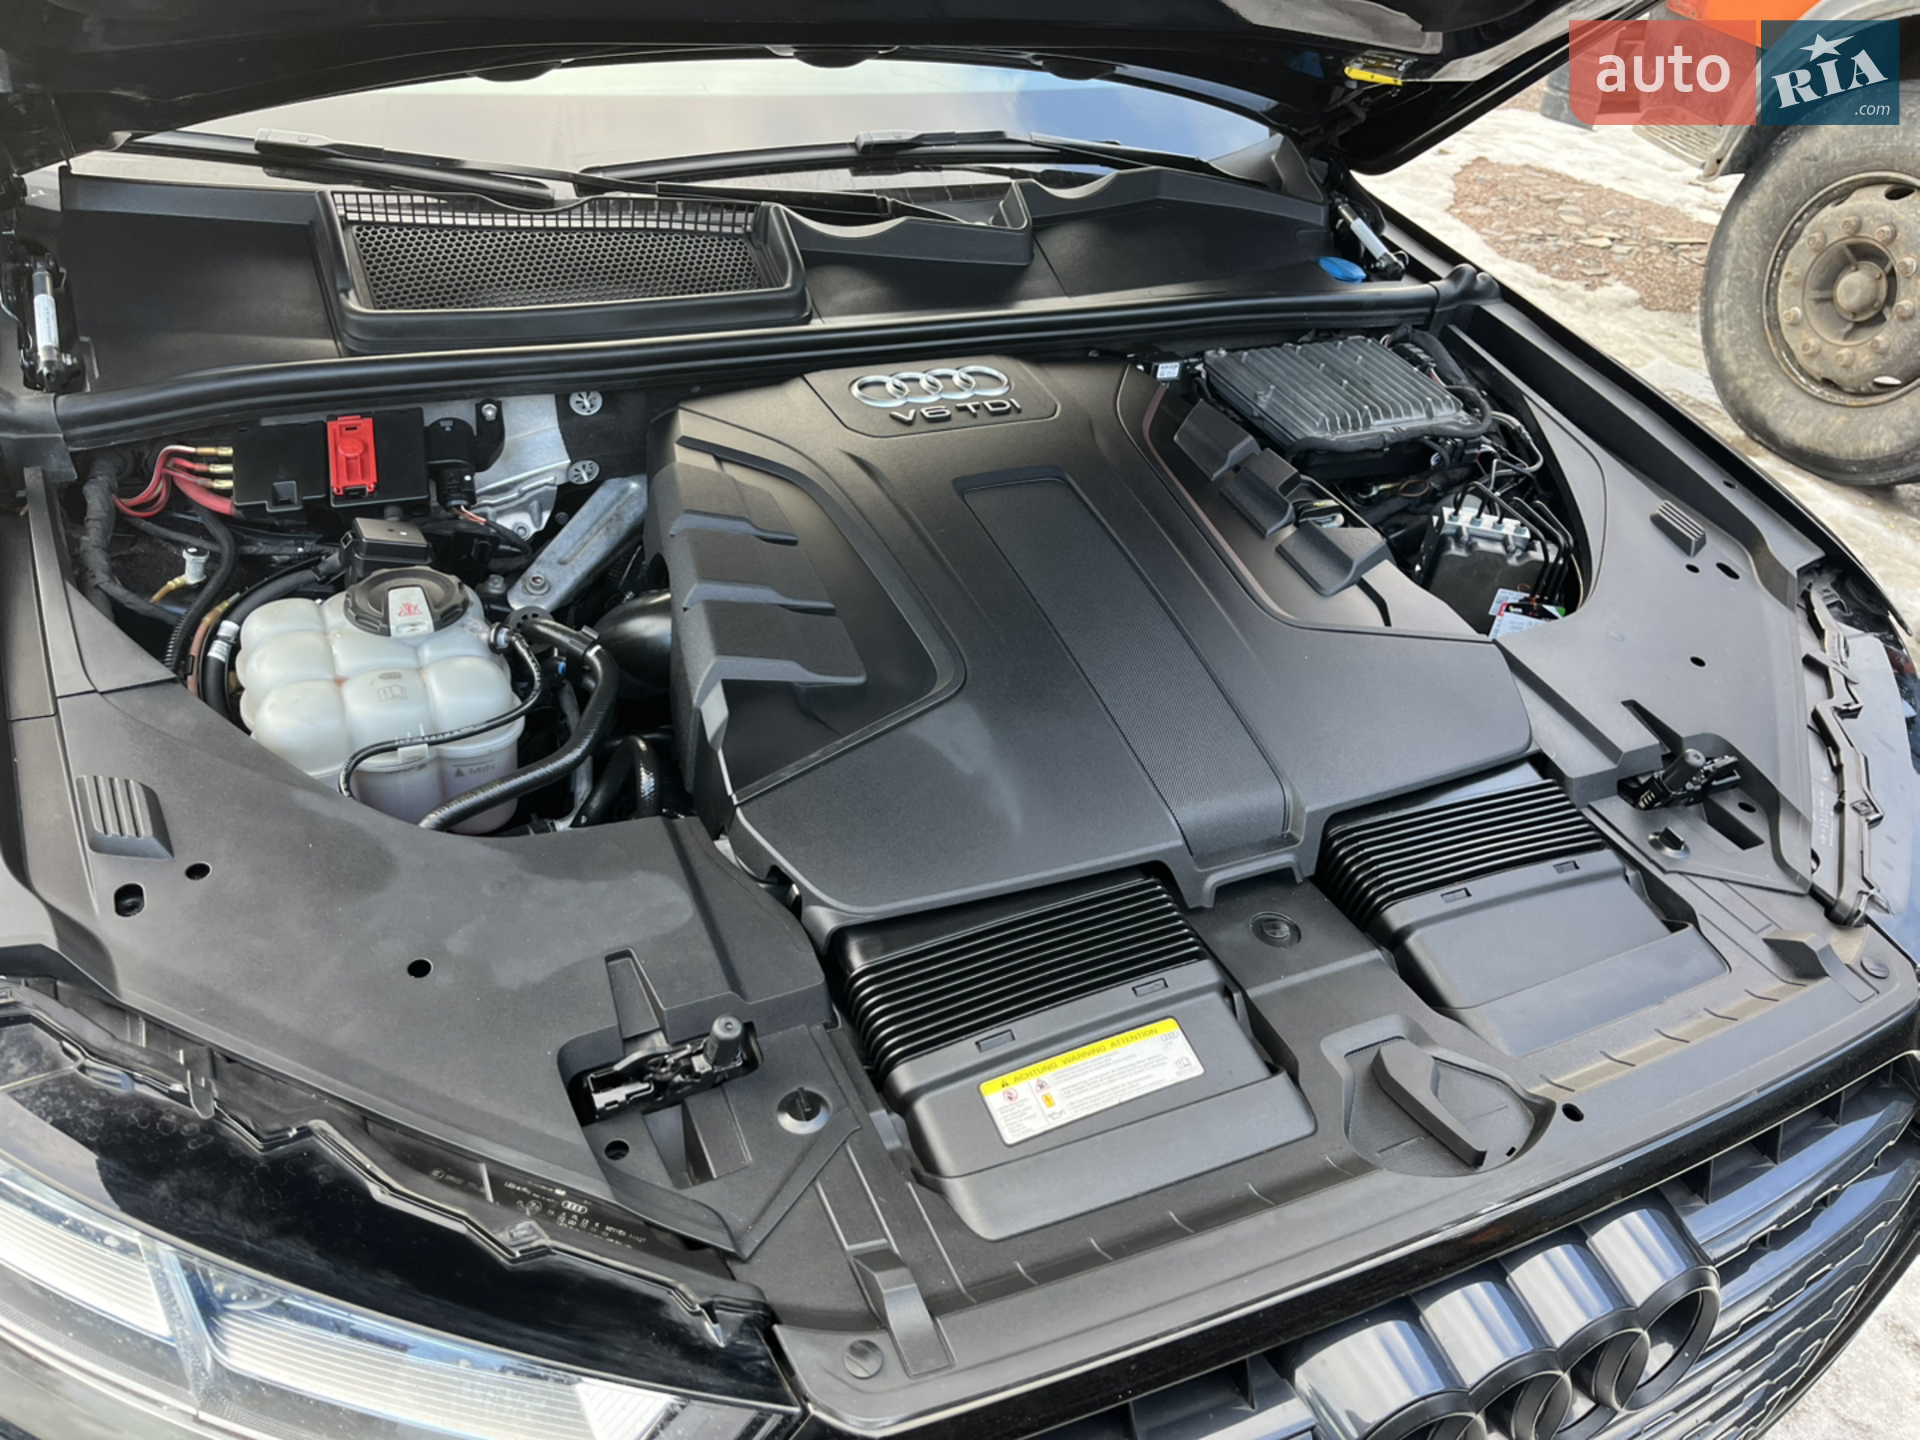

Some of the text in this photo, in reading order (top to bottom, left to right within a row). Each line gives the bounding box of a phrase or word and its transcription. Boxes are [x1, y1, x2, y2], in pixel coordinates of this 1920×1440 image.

[889, 398, 1021, 426] V6 TDI
[468, 763, 496, 775] MIN
[1013, 1027, 1159, 1083] ACHTUNG WARNING ATTENTION
